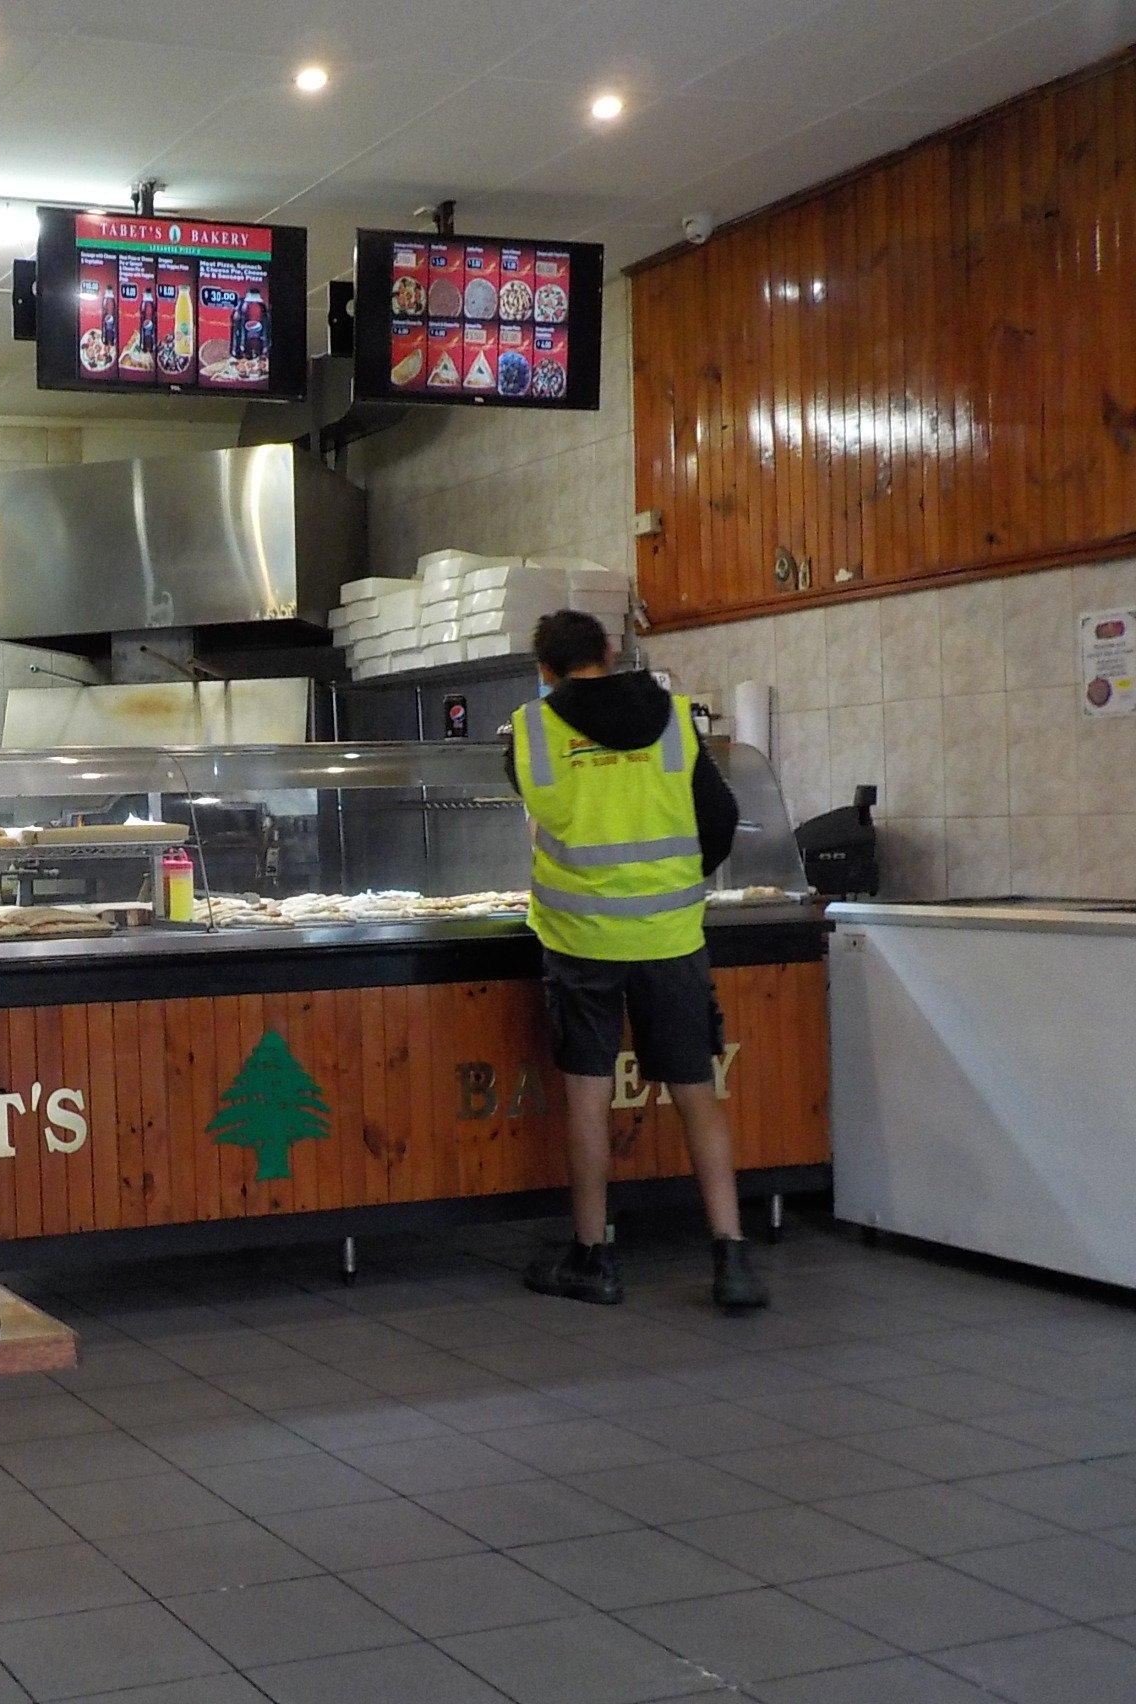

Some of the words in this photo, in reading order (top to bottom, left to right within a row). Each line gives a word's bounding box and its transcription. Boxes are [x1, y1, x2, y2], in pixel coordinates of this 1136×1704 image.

[100, 222, 162, 239] TABET'S
[191, 229, 249, 246] BAKERY
[199, 260, 215, 268] Meat
[207, 267, 229, 275] Cheese
[244, 269, 267, 277] Cheese
[210, 290, 236, 302] 30.00
[456, 1042, 741, 1120] BAEY
